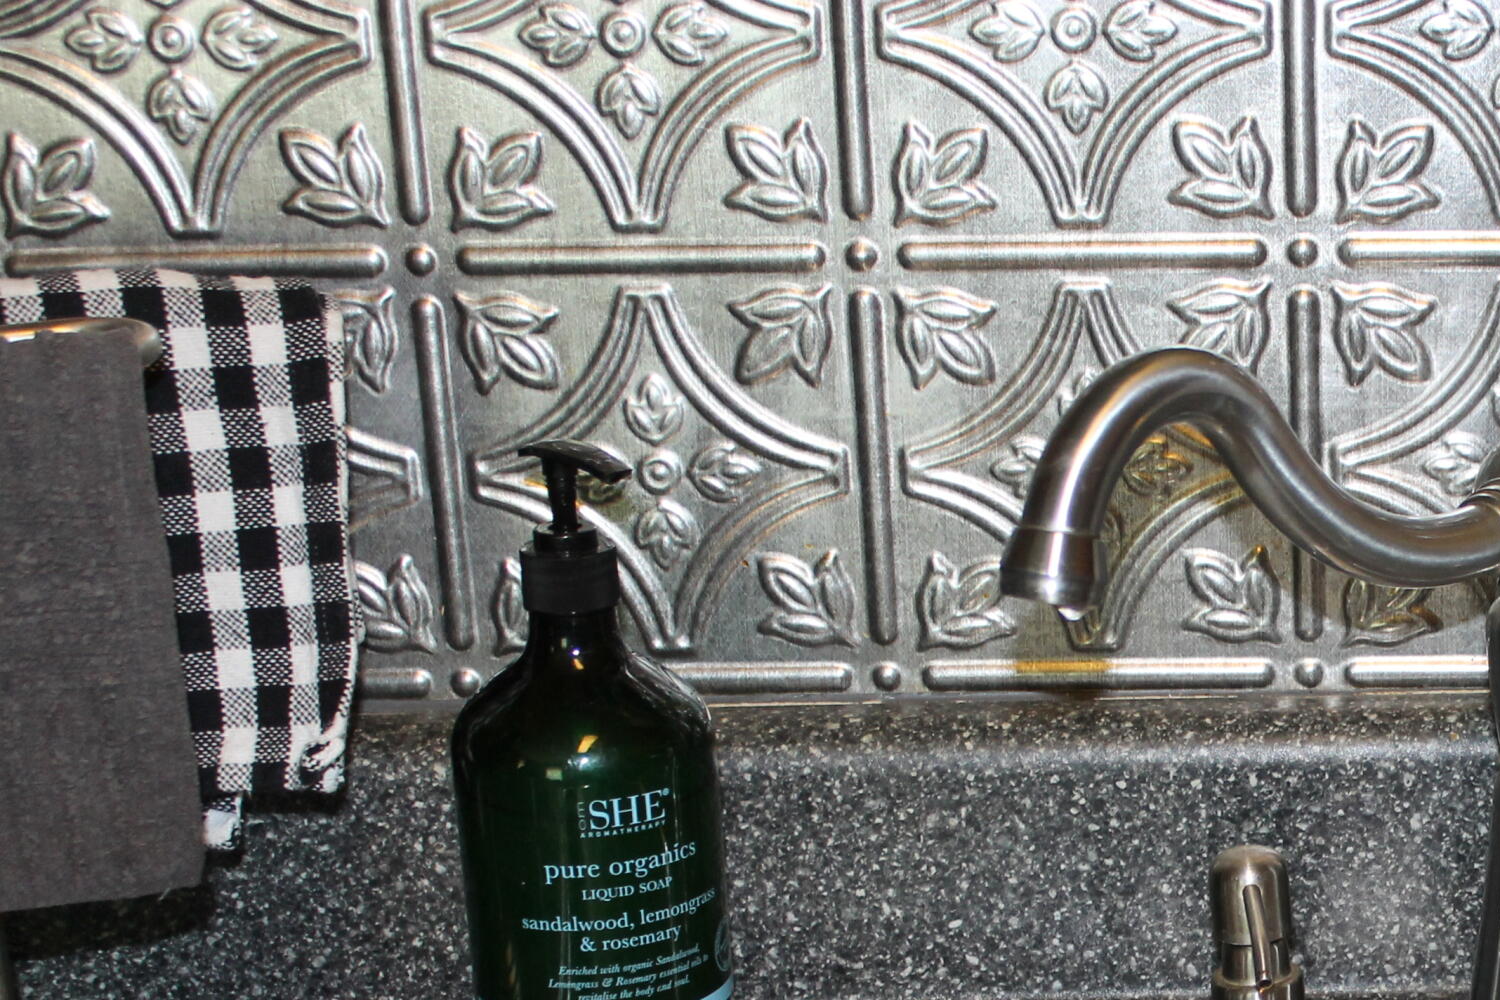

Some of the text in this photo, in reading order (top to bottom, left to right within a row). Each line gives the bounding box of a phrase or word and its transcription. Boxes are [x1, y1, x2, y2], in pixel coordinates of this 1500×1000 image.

[580, 820, 666, 838] AROMATHERAPY
[544, 842, 696, 884] pure organics
[582, 876, 673, 901] LIQUID SOAP
[522, 888, 715, 932] sandalwood, lemongrass
[580, 925, 681, 952] & rosemary
[559, 965, 597, 976] Enriched
[600, 963, 620, 974] with
[623, 958, 653, 973] organic
[548, 978, 599, 991] Lemongrass
[616, 973, 657, 987] Rosemary
[620, 989, 633, 999] the
[635, 985, 654, 997] body
